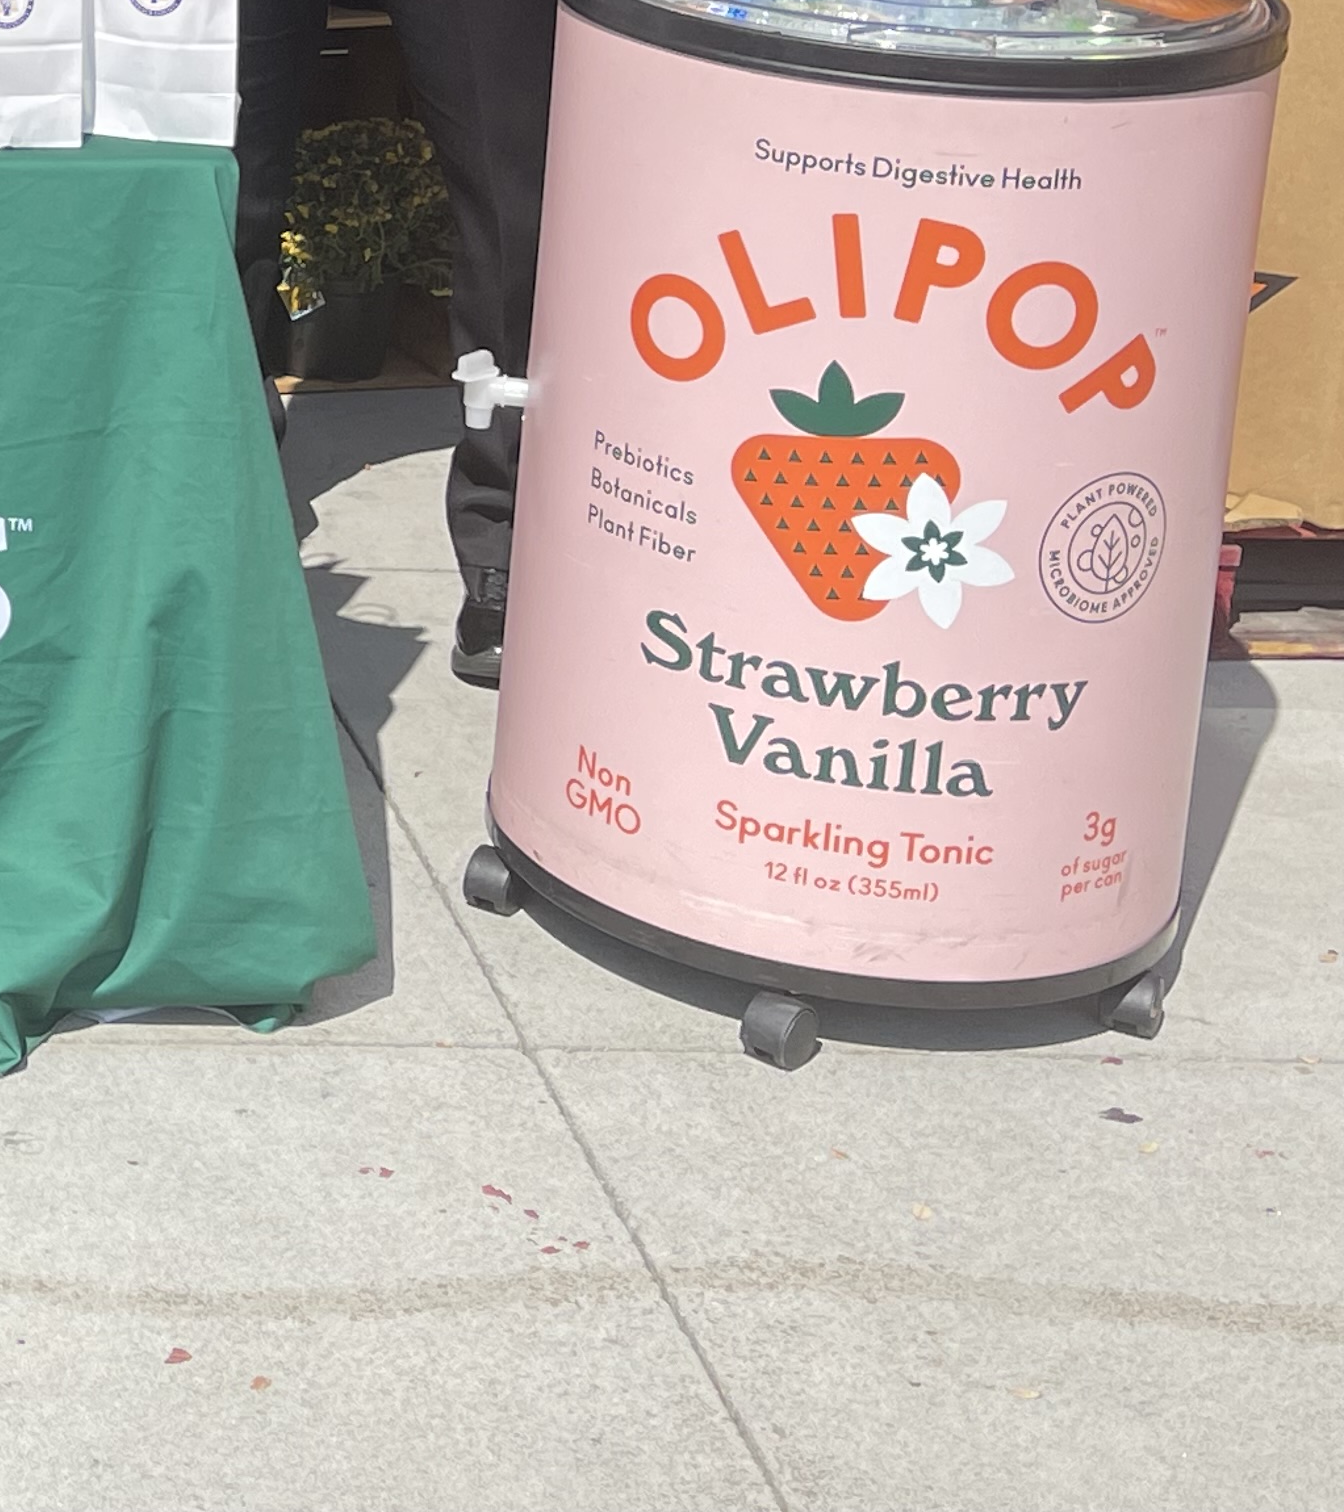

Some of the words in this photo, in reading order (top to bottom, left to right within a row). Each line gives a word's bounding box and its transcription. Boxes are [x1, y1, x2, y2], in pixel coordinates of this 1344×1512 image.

[754, 137, 866, 175] Supports
[872, 156, 996, 189] Digestive
[1001, 167, 1083, 190] Health
[630, 213, 1156, 414] OLIPOP
[593, 429, 695, 486] Prebiotics
[590, 466, 698, 525] Botanicals
[1060, 487, 1103, 530] PLANT
[1107, 481, 1158, 518] POWERED
[587, 502, 635, 542] Plant
[638, 525, 697, 563] Fiber
[1048, 548, 1109, 615] MICROBIOME
[1112, 536, 1159, 611] APPROVED
[640, 609, 1089, 732] Strawberry
[578, 744, 631, 797] Non
[708, 701, 994, 798] Vanilla
[565, 778, 641, 835] GMO
[714, 798, 890, 869] Sparkling
[900, 831, 995, 866] Tonic
[1083, 811, 1118, 847] 3g
[764, 860, 788, 882] 12
[793, 866, 808, 887] fl
[813, 875, 841, 892] oz
[847, 873, 940, 903] (355ml)
[1060, 855, 1081, 877] of
[1082, 849, 1128, 875] sugar
[1060, 879, 1092, 903] per
[1094, 871, 1123, 890] can
